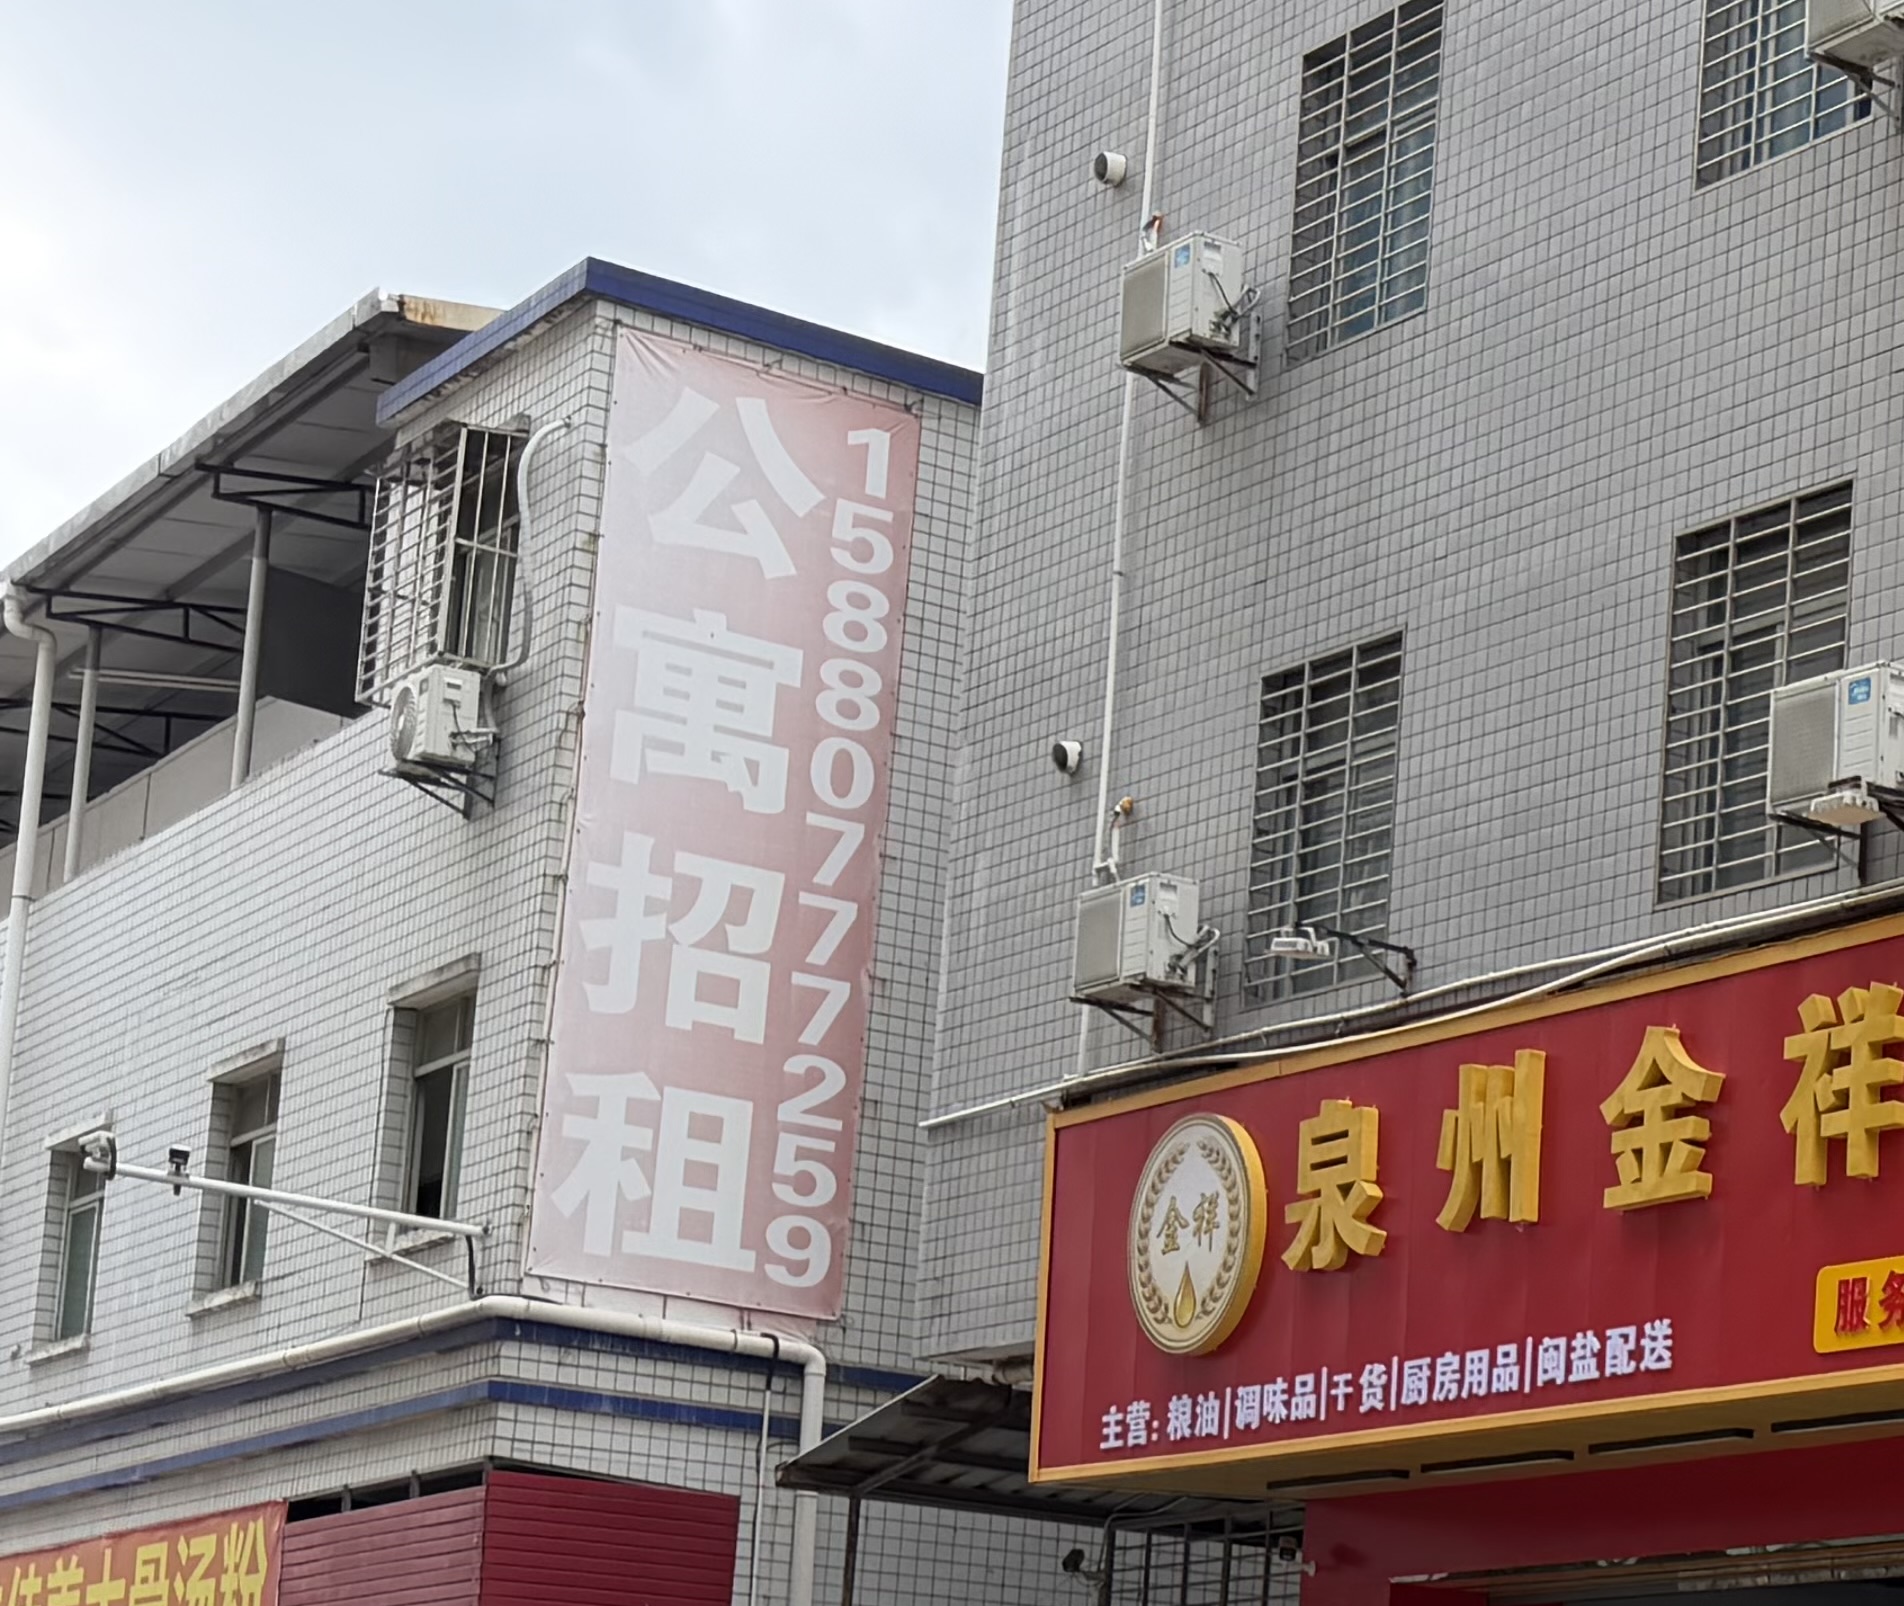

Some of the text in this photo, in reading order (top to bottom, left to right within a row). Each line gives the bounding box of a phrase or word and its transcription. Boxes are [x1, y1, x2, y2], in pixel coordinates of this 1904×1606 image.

[551, 386, 825, 1273] 公寓招租
[764, 426, 895, 1288] 15880777259
[1156, 1190, 1221, 1256] 金祥
